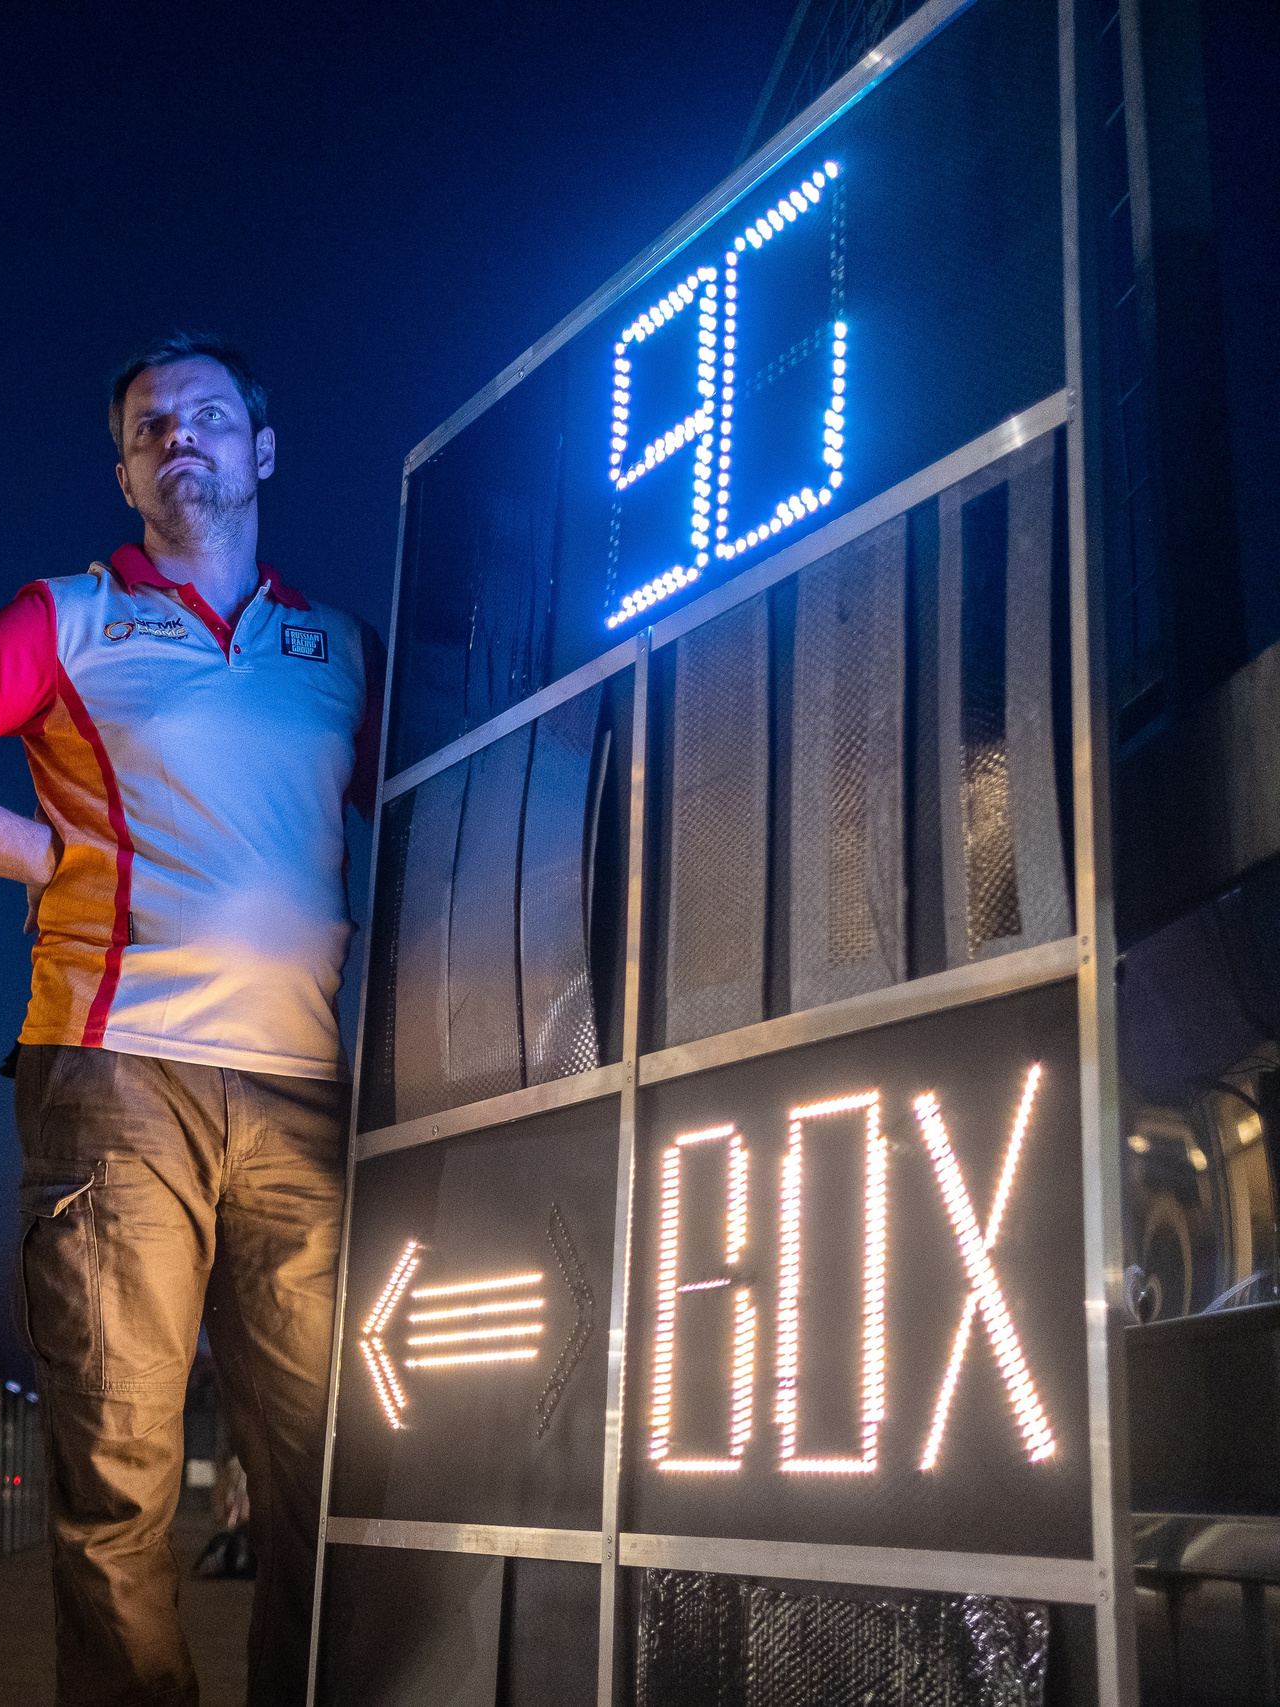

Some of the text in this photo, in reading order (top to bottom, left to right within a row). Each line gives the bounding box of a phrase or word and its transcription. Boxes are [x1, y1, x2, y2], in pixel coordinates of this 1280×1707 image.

[606, 160, 849, 630] 90
[291, 631, 319, 641] RUSSIAN
[291, 638, 316, 648] RACING
[292, 645, 314, 654] GROUP
[648, 1060, 1057, 1474] BOX
